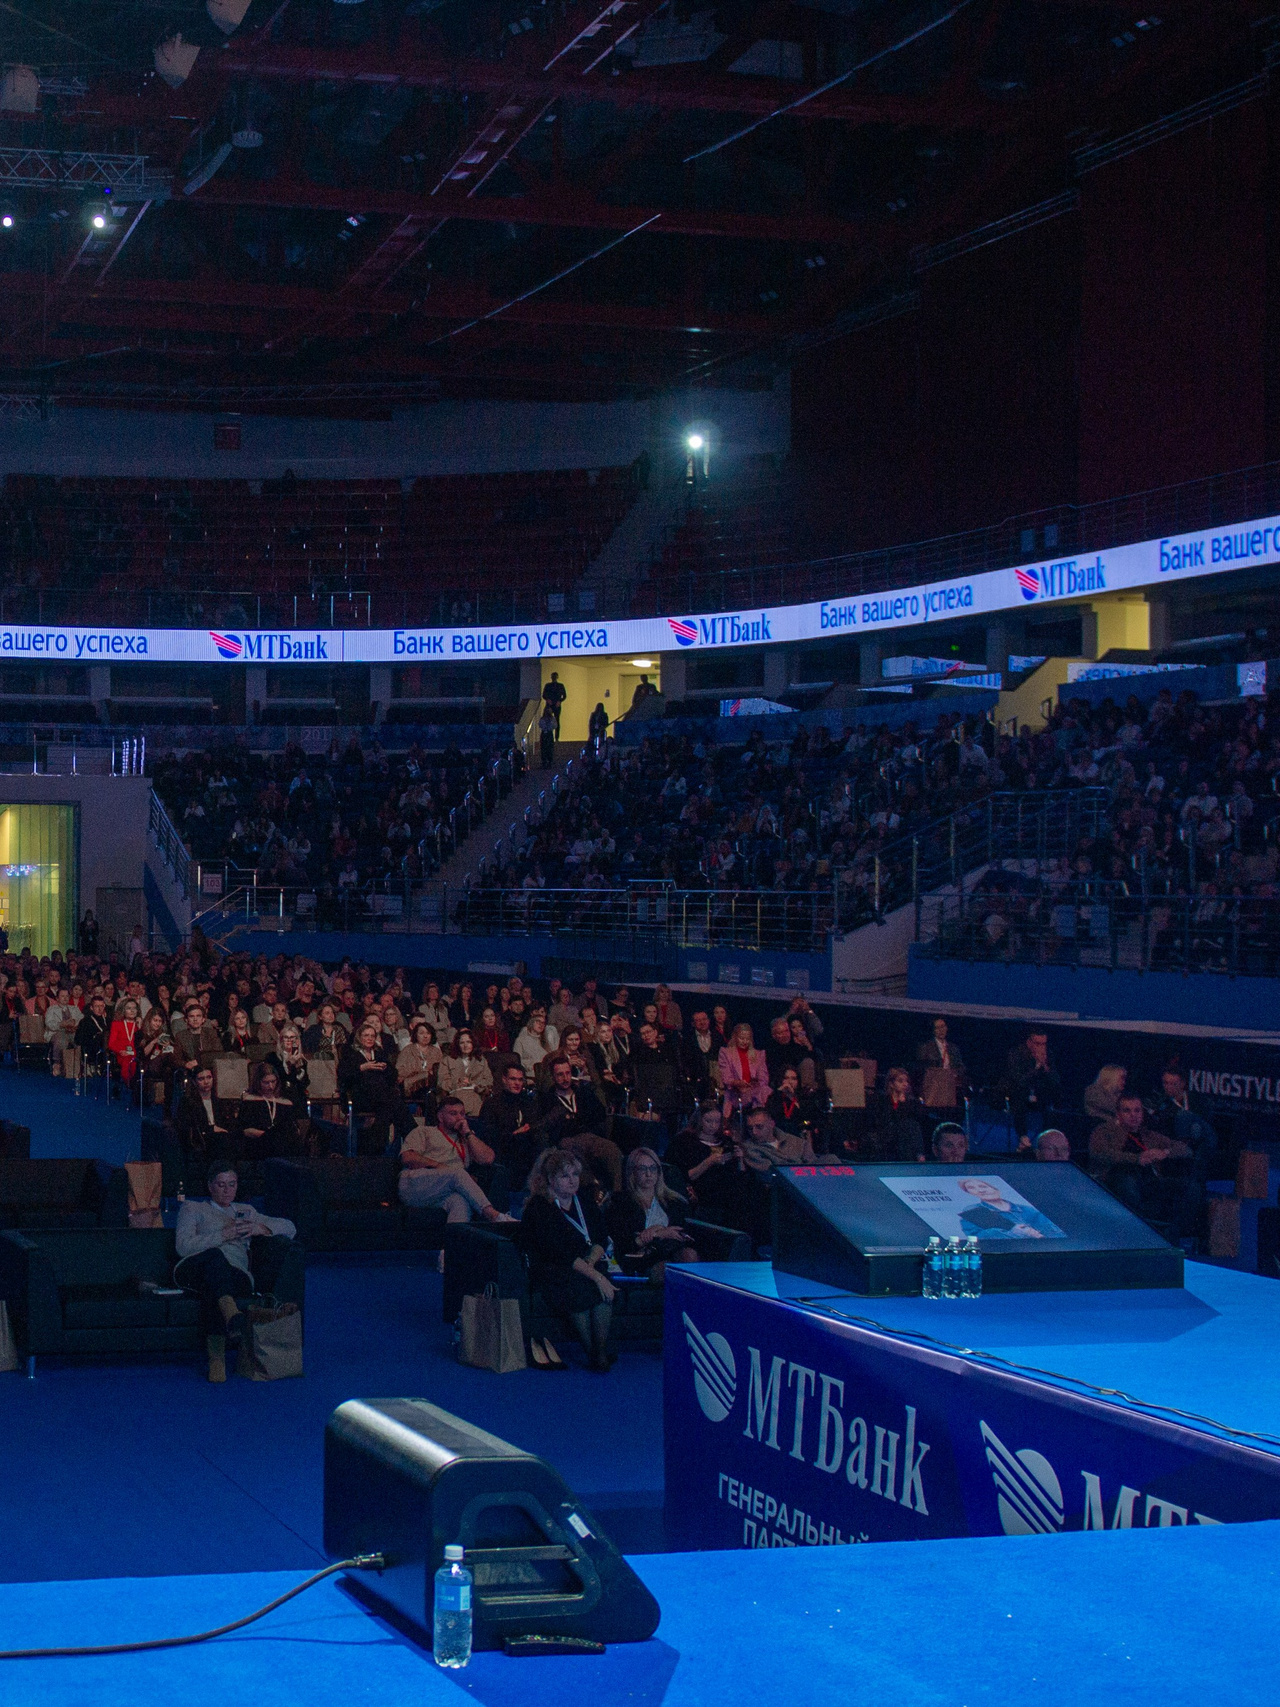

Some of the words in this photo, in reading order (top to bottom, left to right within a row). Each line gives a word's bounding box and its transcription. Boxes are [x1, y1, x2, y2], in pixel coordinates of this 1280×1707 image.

[1160, 539, 1205, 572] Банк
[1040, 556, 1106, 599] МТБанк
[821, 602, 856, 629] Банк
[862, 595, 919, 623] вашего
[923, 584, 973, 622] успеха
[393, 631, 443, 654] Банк
[452, 631, 529, 653] вашего
[536, 628, 608, 656] успеха
[699, 613, 771, 645] МТБанк
[75, 634, 148, 657] успеха
[243, 634, 328, 660] МТБанк
[743, 1346, 930, 1516] МТБанк
